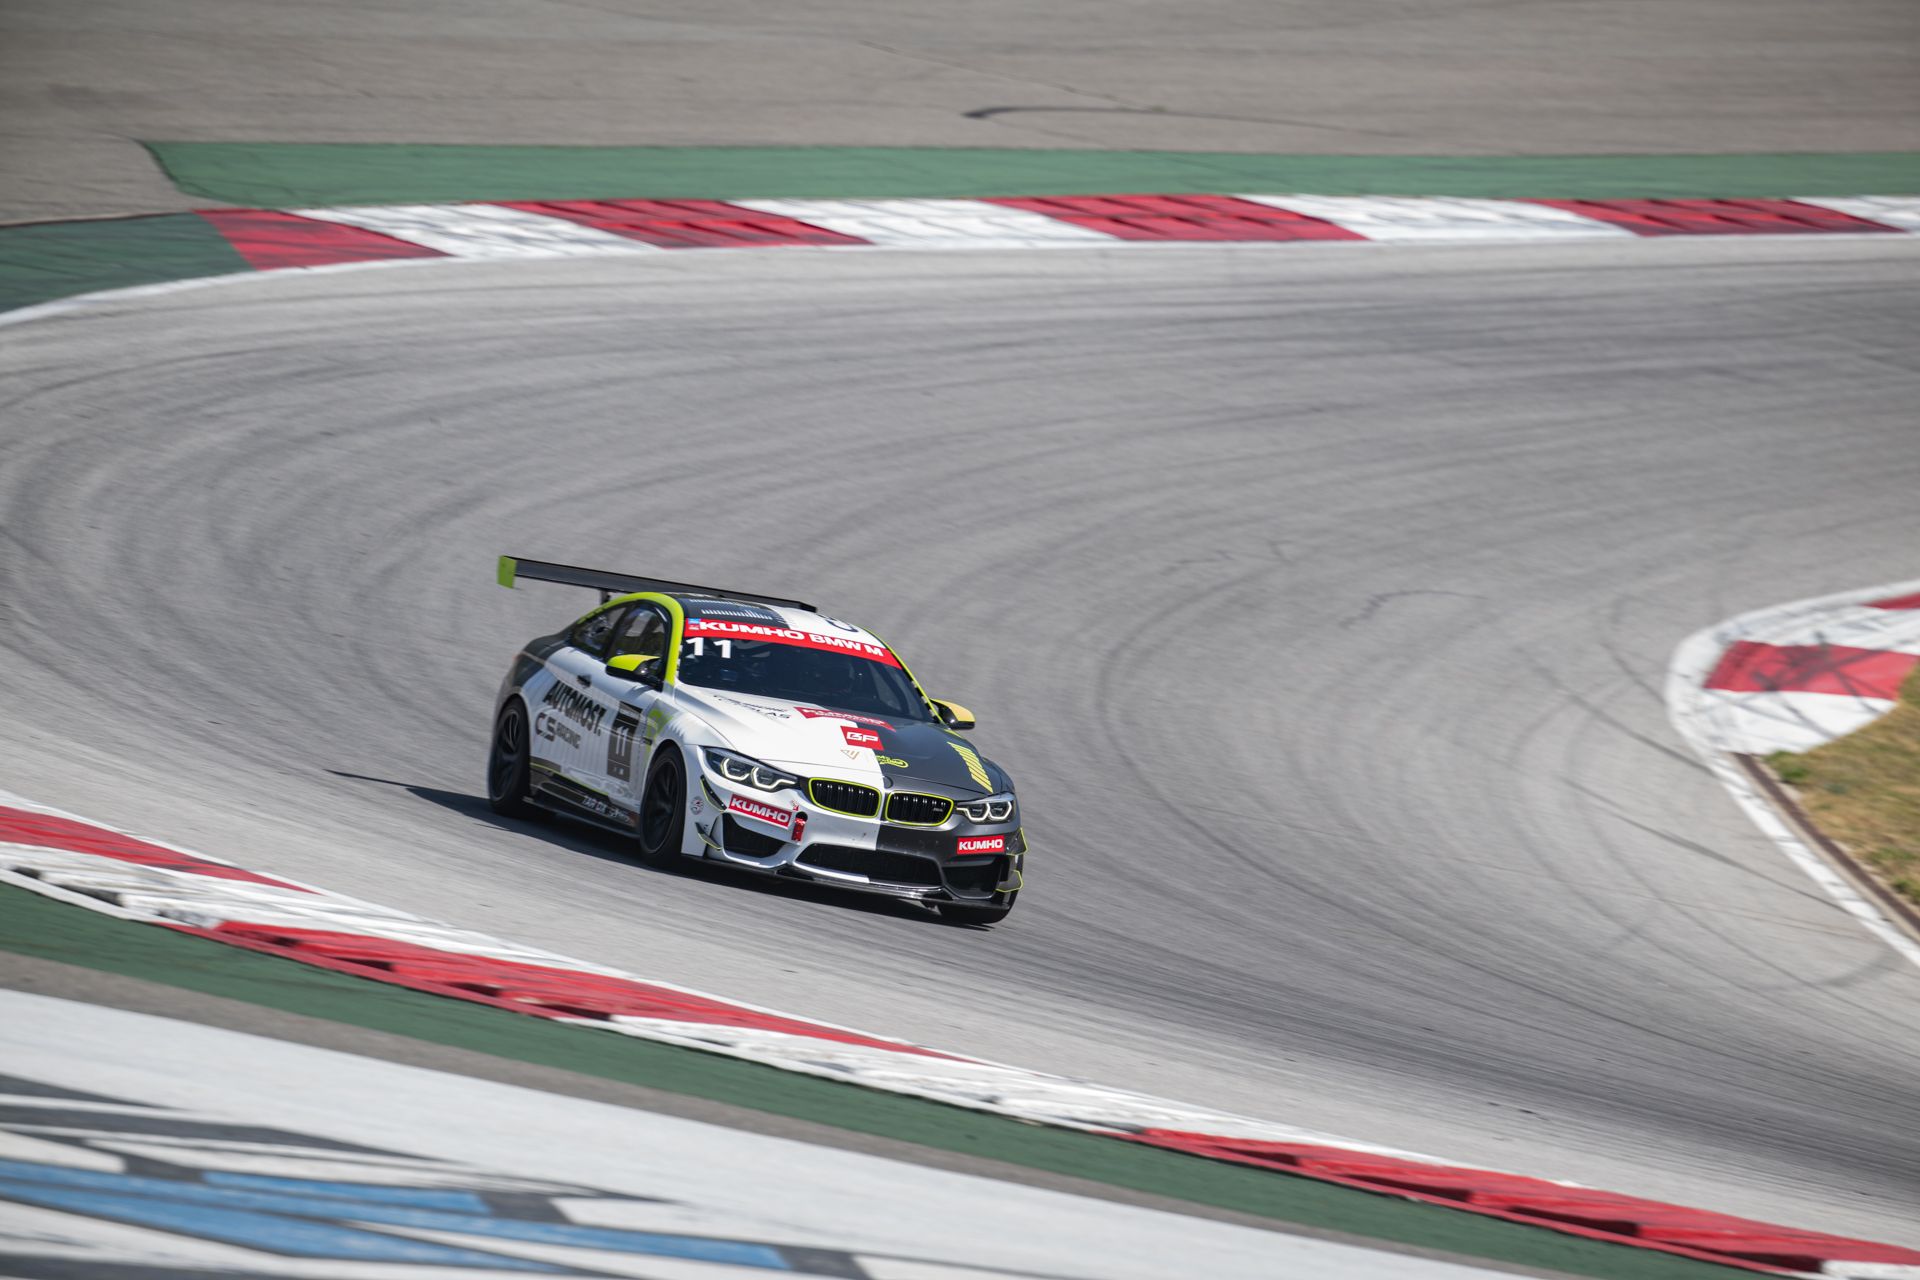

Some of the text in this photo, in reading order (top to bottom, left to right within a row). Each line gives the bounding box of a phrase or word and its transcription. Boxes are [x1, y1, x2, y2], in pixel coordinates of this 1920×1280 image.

[686, 637, 732, 659] 11
[700, 621, 885, 657] KUMHO BMW M
[731, 797, 790, 823] KUMHO
[958, 838, 1004, 851] KUMHO
